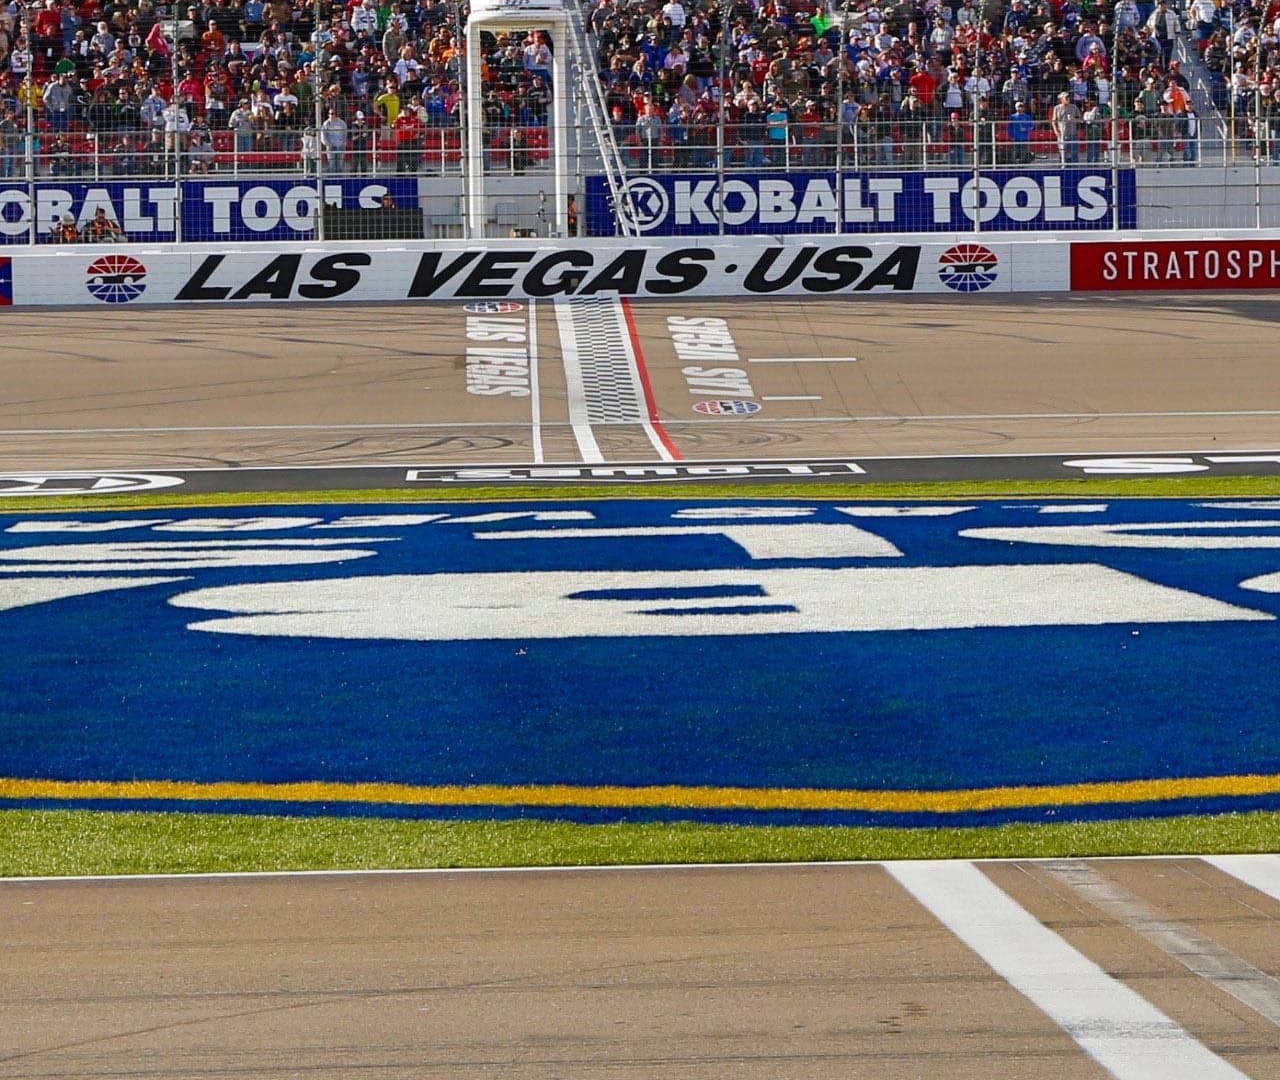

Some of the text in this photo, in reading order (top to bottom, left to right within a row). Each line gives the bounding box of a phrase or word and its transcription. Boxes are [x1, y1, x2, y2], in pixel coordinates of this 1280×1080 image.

[674, 177, 903, 225] KOBALT
[924, 175, 1109, 222] TOOLS
[174, 252, 371, 300] LAS
[465, 316, 530, 397] LAS VEGAS
[667, 316, 754, 398] LAS VEGAS
